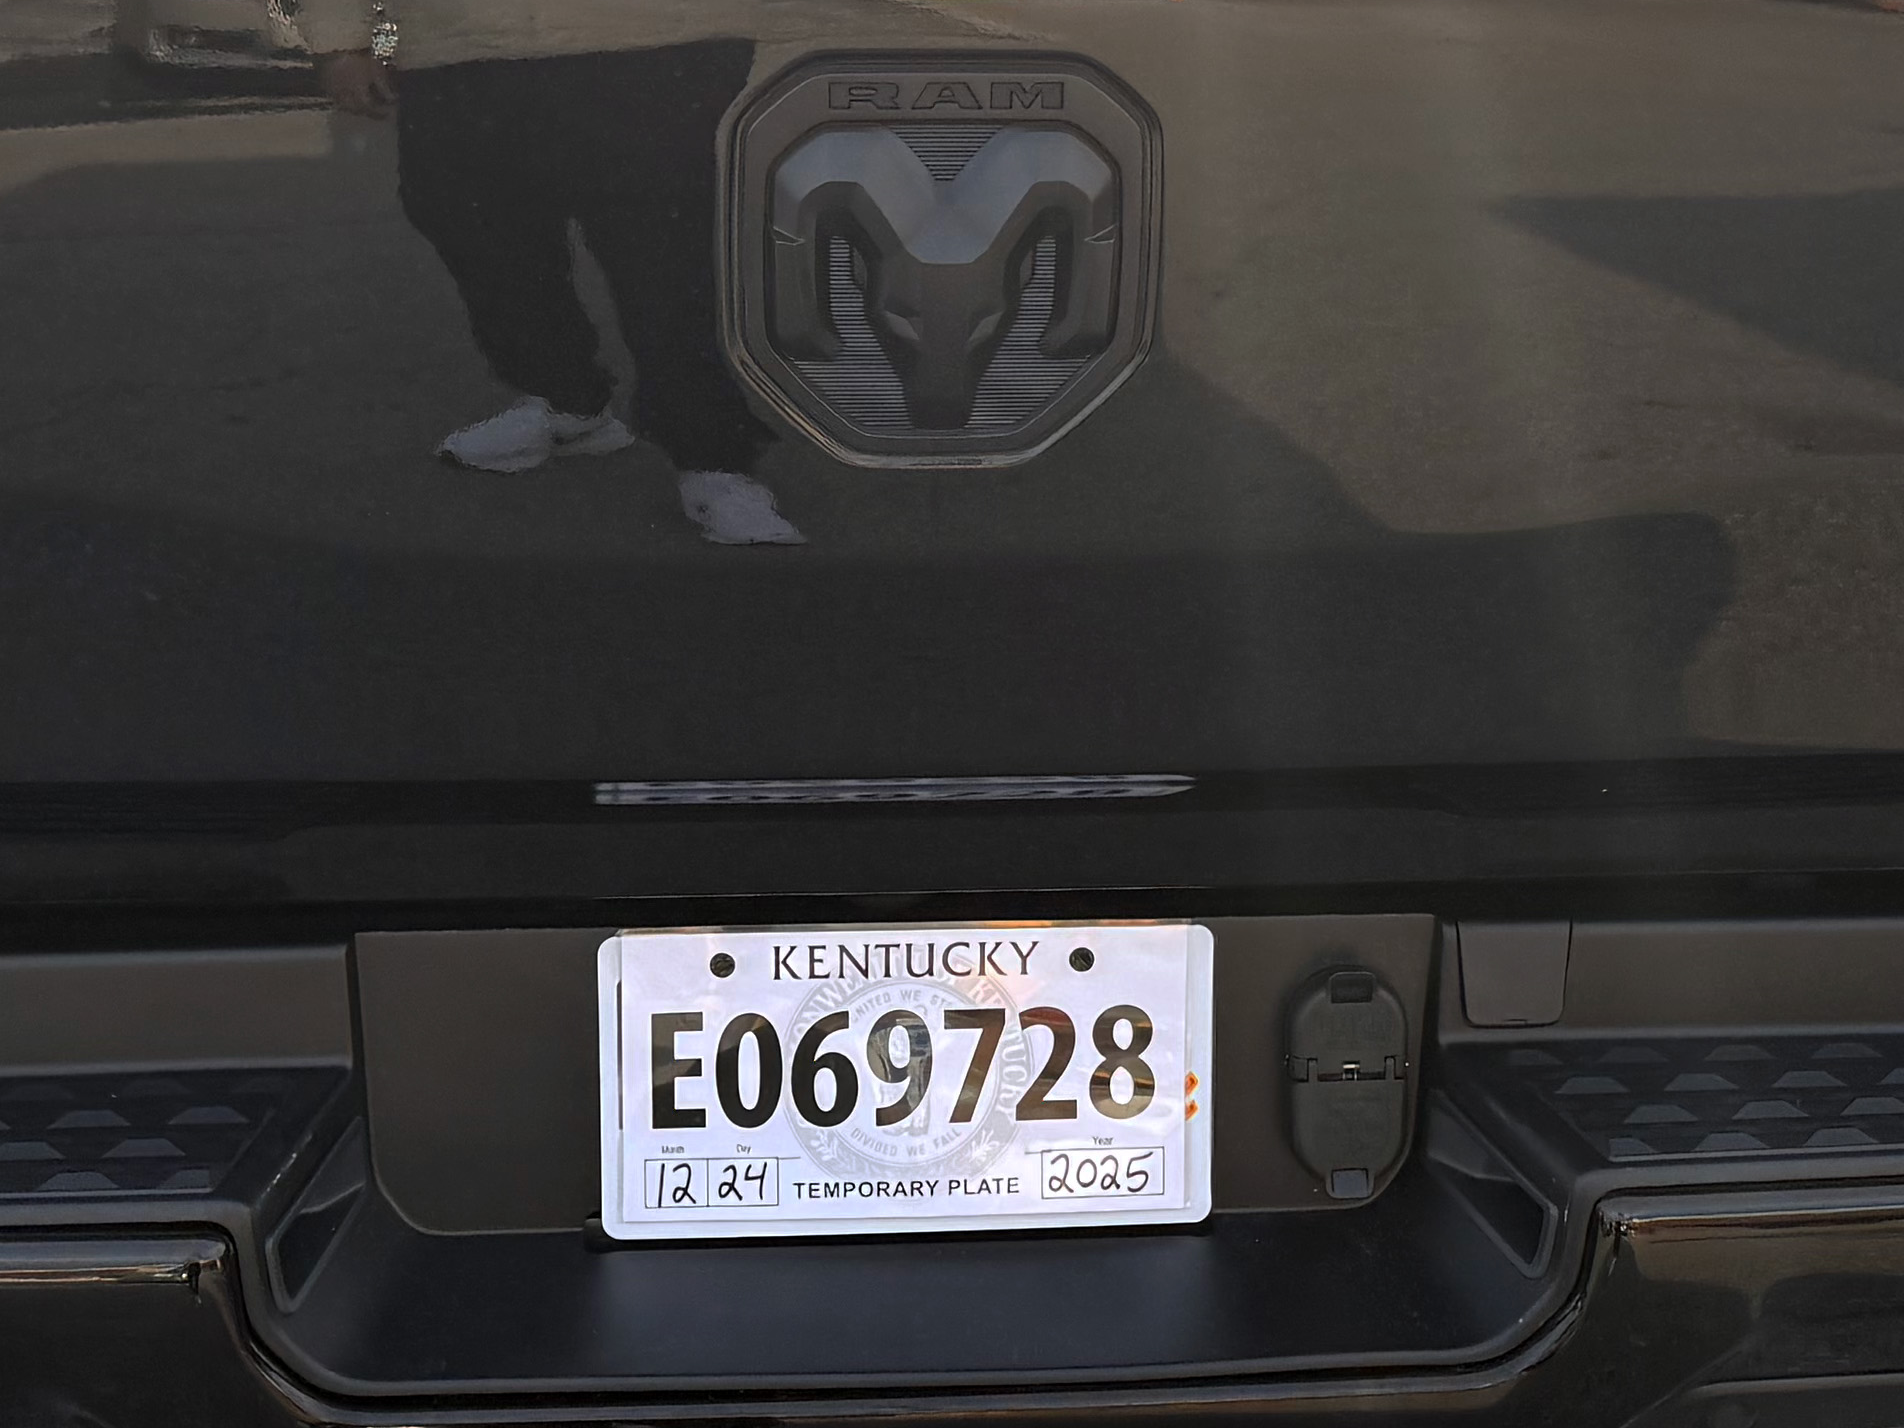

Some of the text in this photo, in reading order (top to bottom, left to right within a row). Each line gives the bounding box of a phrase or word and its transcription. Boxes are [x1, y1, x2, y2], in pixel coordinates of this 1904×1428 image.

[827, 80, 1065, 111] RAM
[772, 941, 1039, 980] KENTUCKY
[650, 1004, 1156, 1129] E069728
[657, 1162, 697, 1208] 12
[717, 1161, 768, 1202] 24
[793, 1177, 1020, 1200] TEMPORARY PLATE
[1048, 1151, 1154, 1193] 2025
